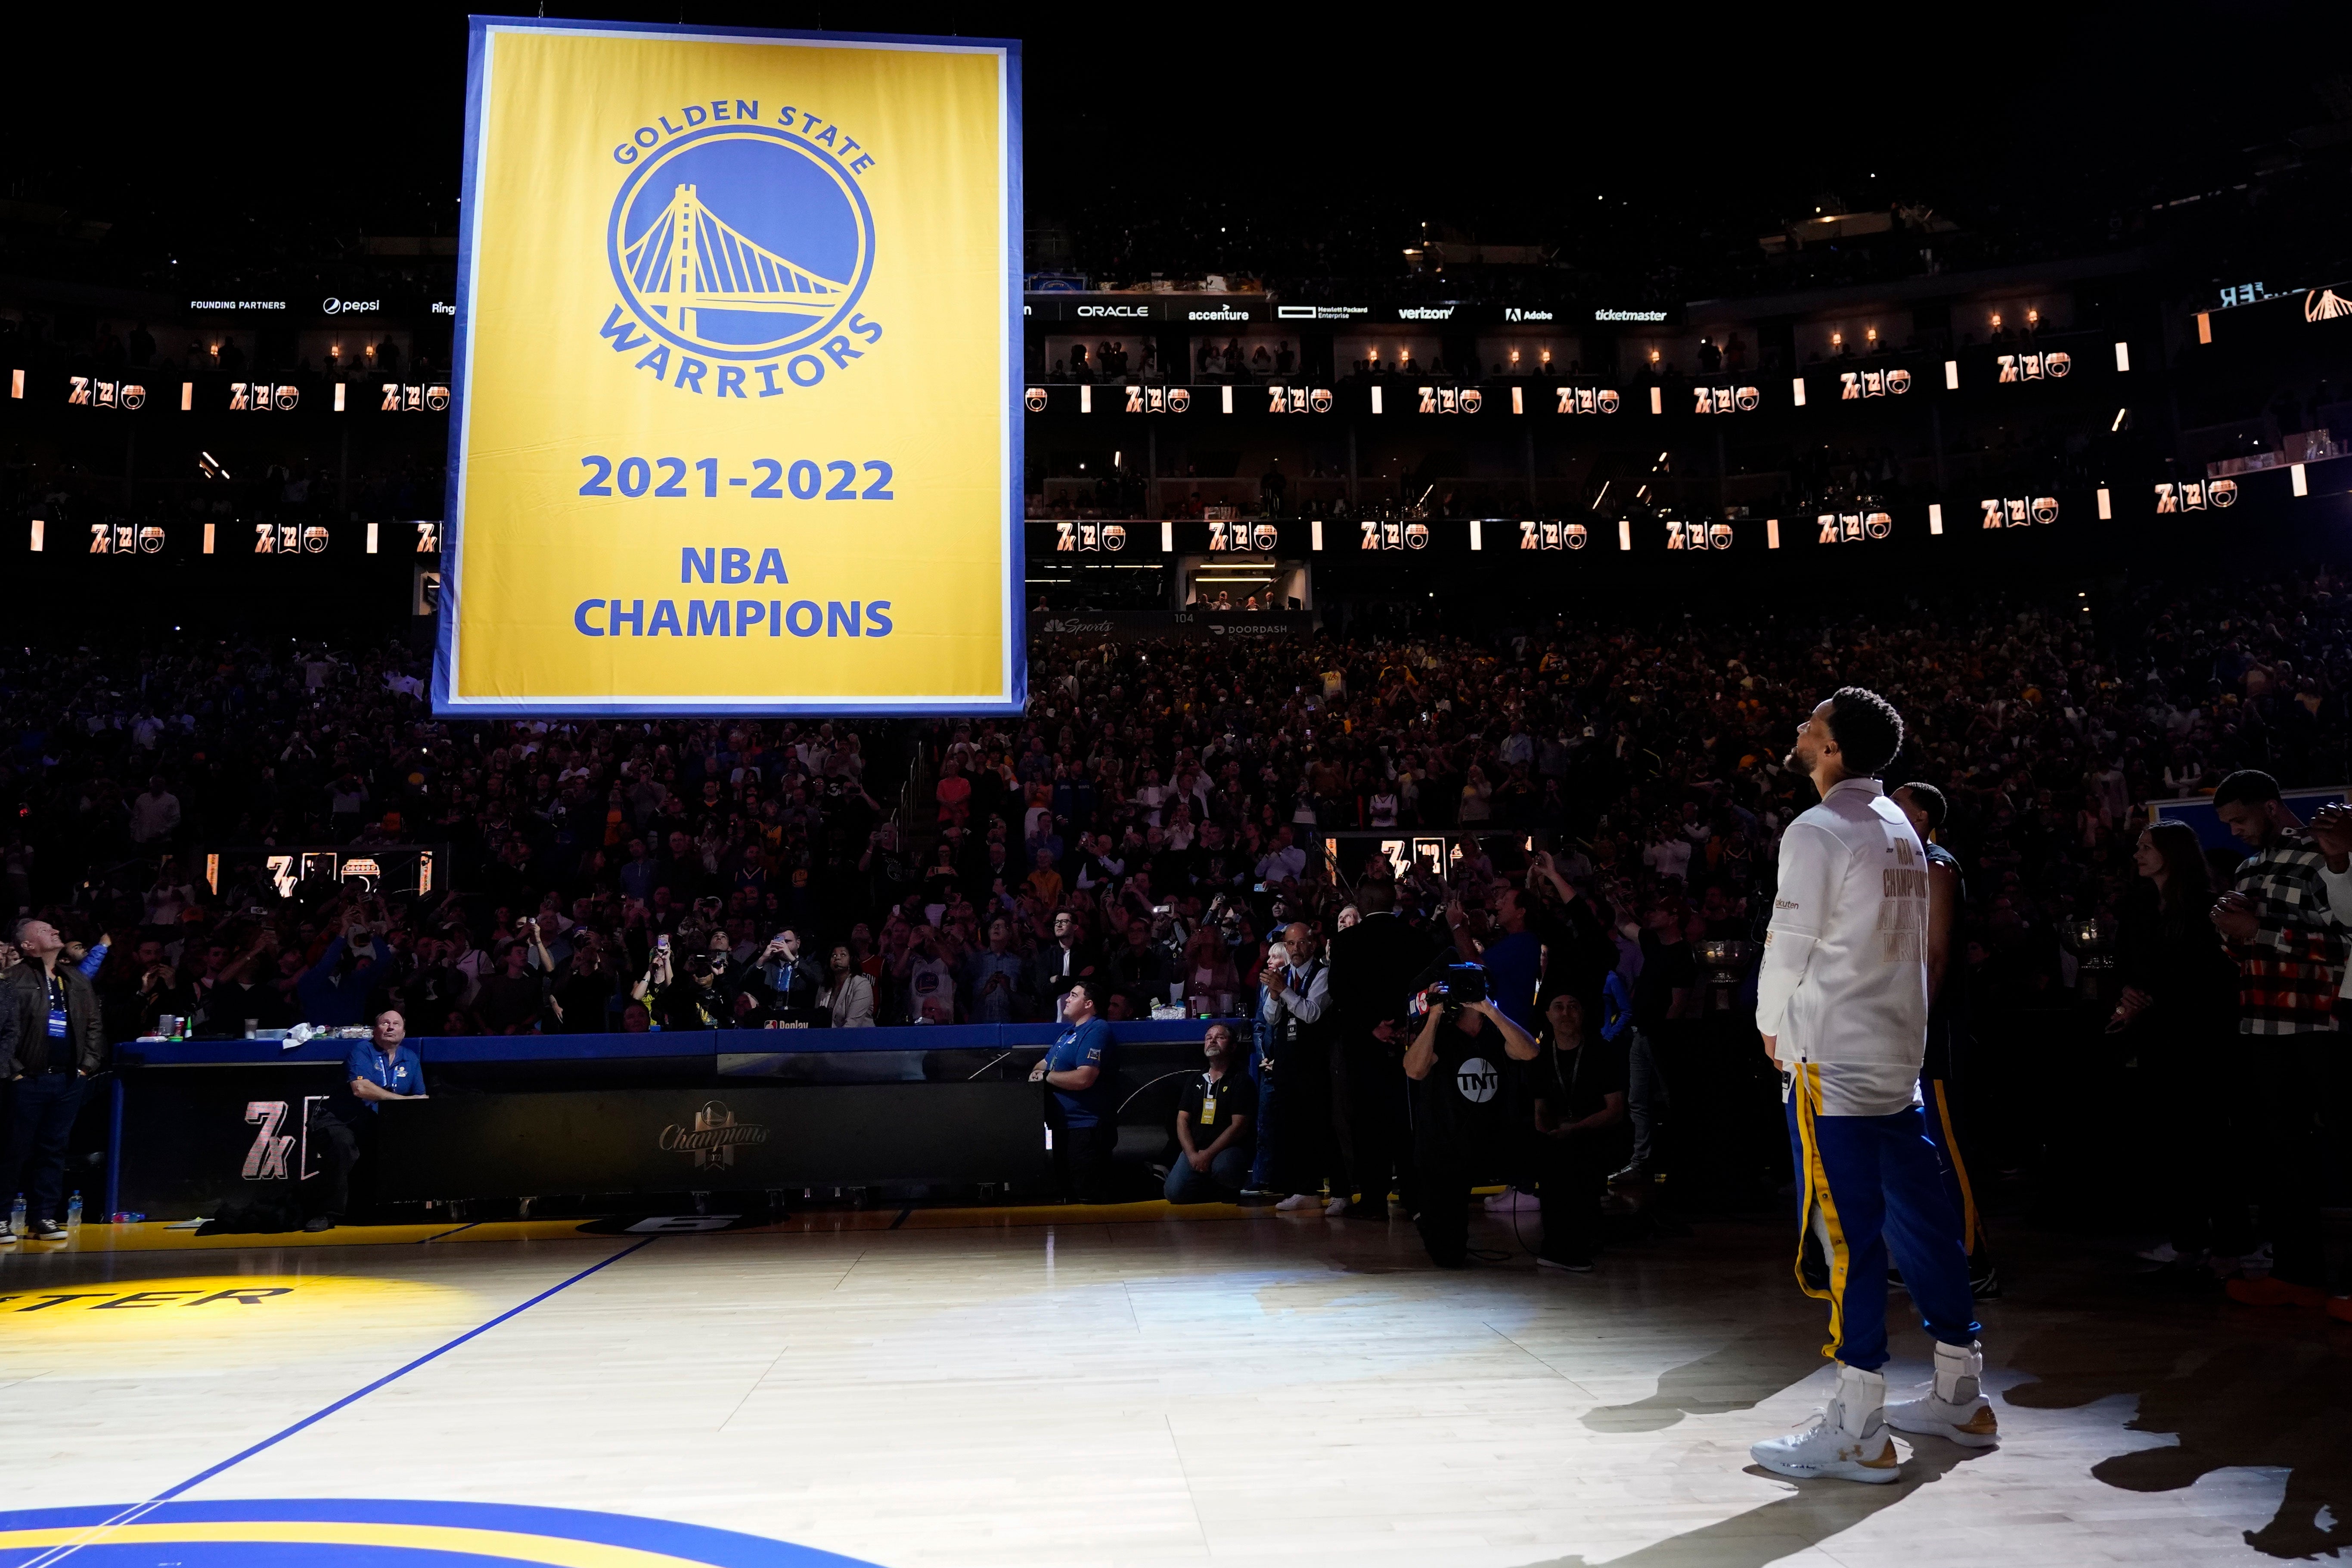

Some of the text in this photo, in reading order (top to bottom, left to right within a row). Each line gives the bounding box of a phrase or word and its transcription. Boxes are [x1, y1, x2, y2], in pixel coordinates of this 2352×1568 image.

[614, 100, 875, 174] GOLDEN STATE
[239, 301, 285, 309] PARTNERS
[342, 299, 379, 313] pepsi
[432, 301, 456, 315] Ring
[1077, 306, 1149, 317] ORACLE
[1188, 307, 1249, 320] accenture
[1398, 307, 1447, 320] verizon
[1523, 310, 1553, 320] Adobe
[1595, 309, 1667, 321] ticketmaster
[600, 304, 882, 398] WARRIORS
[579, 455, 893, 500] 2021-2022
[681, 547, 788, 584] NBA
[574, 599, 892, 637] CHAMPIONS
[1174, 614, 1194, 623] 104
[1064, 618, 1114, 635] Sports
[1229, 625, 1287, 634] DOORDASH
[1883, 868, 1927, 899] CHAMPION
[1775, 898, 1799, 910] akuten
[1458, 1073, 1498, 1091] TNT
[659, 1123, 770, 1152] Champions
